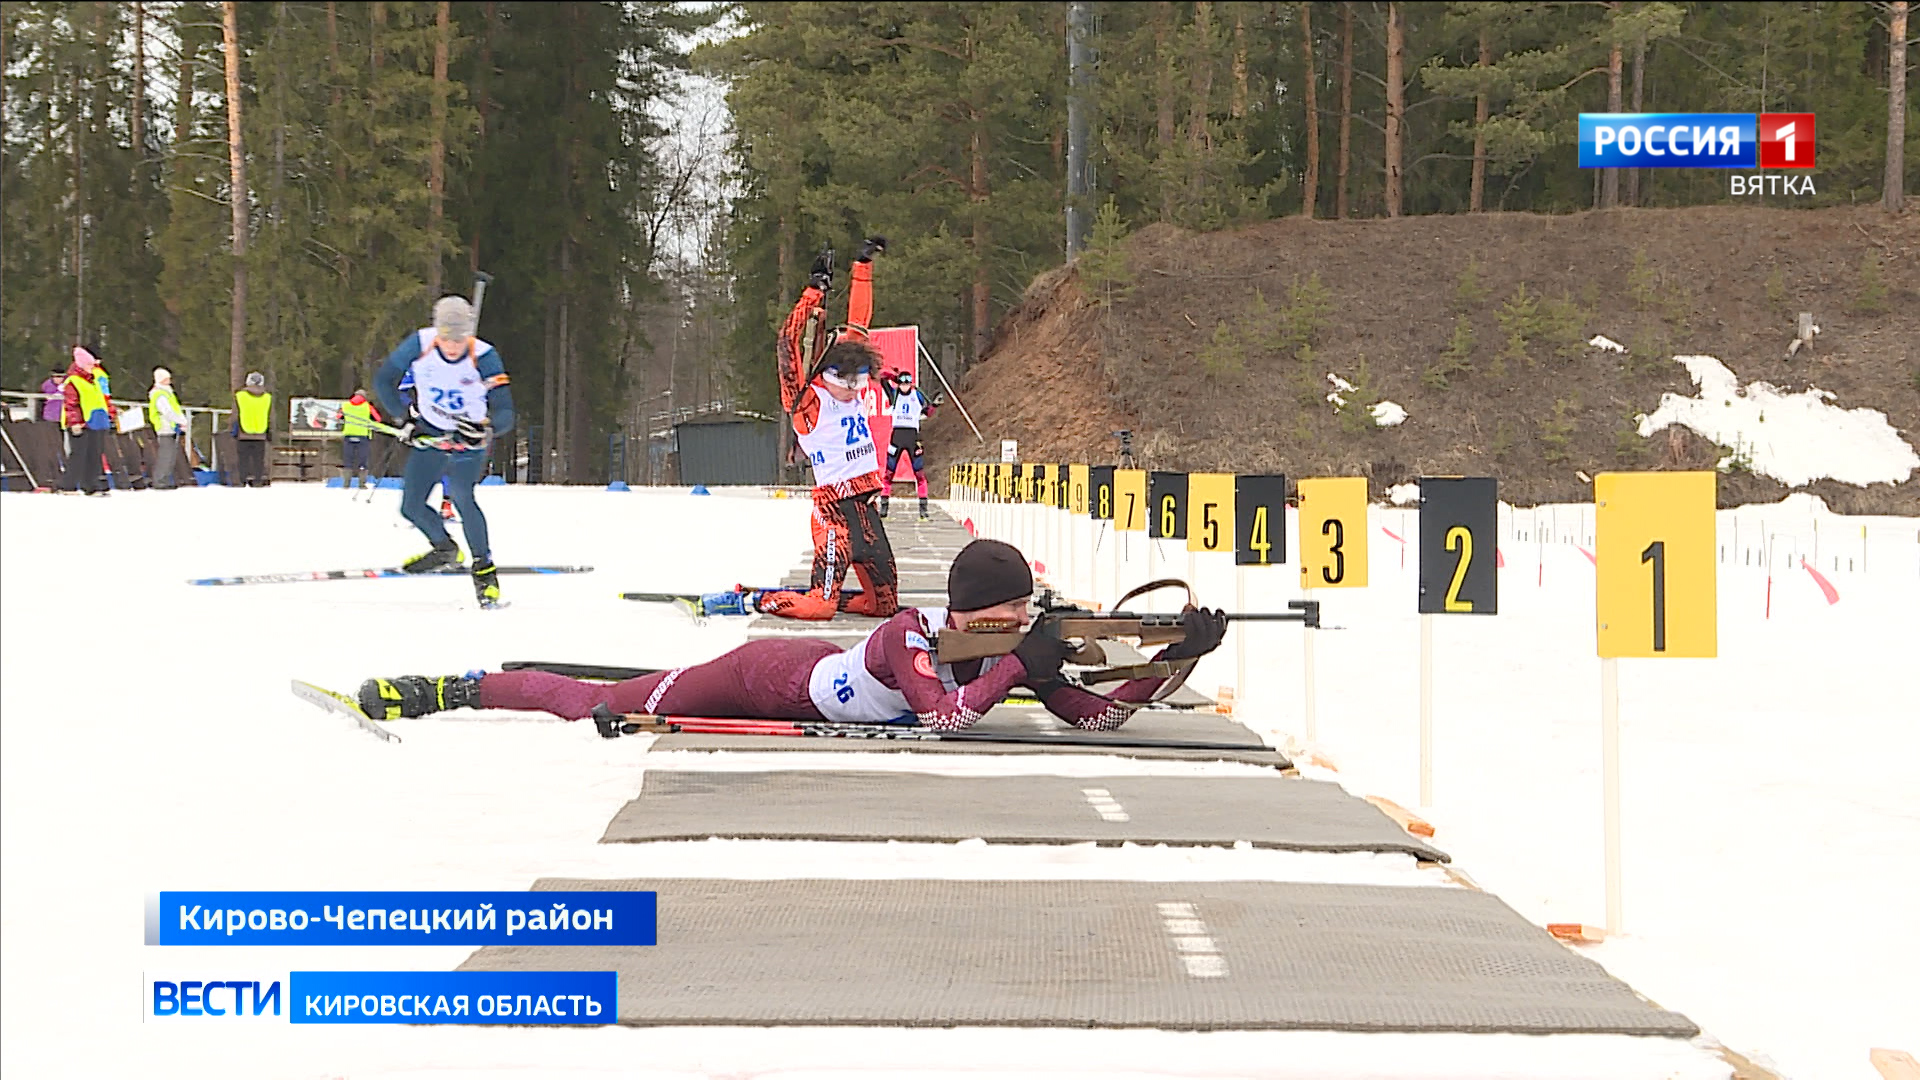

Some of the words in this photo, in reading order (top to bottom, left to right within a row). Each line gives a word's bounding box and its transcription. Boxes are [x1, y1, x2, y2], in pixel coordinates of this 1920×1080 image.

[429, 386, 465, 410] 25
[840, 413, 869, 446] 24
[810, 449, 825, 466] 24
[1076, 483, 1083, 513] 9
[1098, 484, 1110, 519] 8
[1124, 492, 1135, 528] 7
[1160, 493, 1176, 538] 6
[1203, 503, 1218, 550] 5
[1249, 505, 1273, 564] 4
[1321, 518, 1345, 584] 3
[1443, 525, 1475, 613] 2
[1640, 540, 1667, 653] 1
[832, 671, 855, 704] 26
